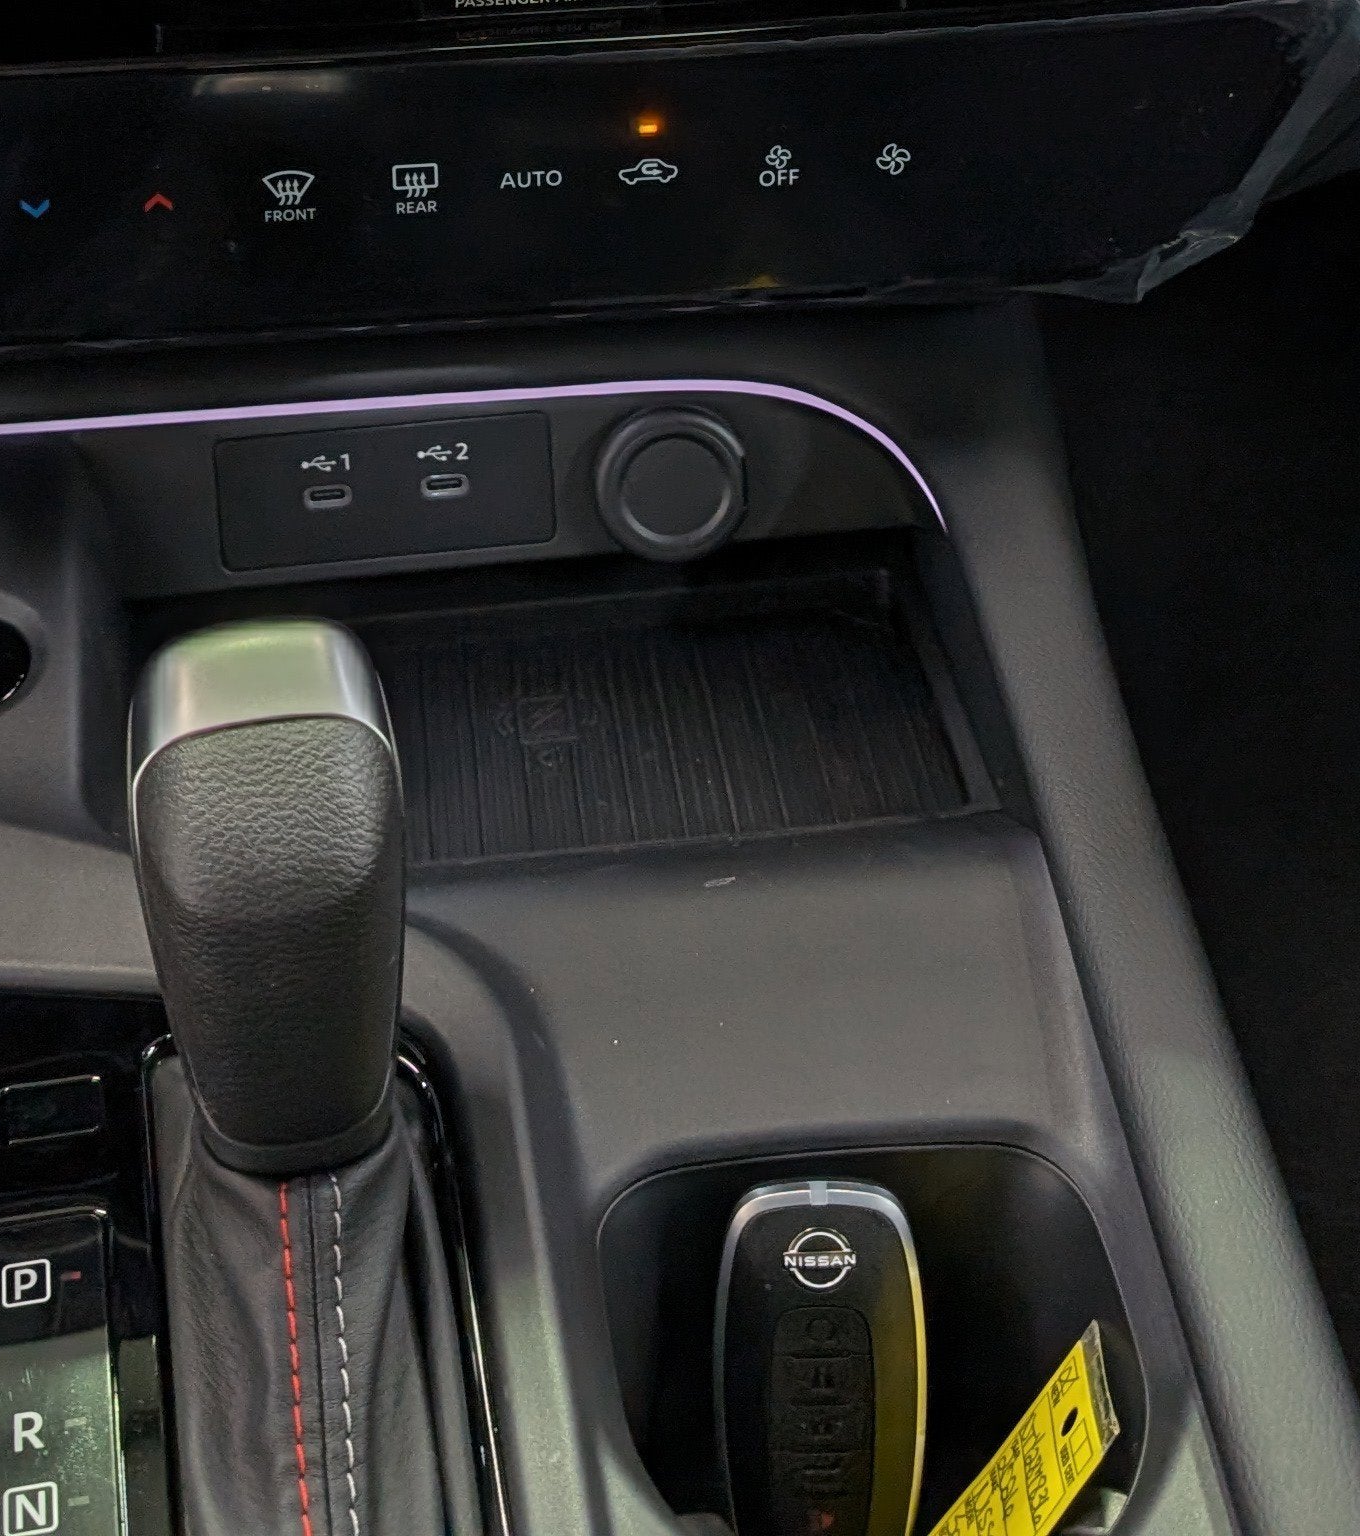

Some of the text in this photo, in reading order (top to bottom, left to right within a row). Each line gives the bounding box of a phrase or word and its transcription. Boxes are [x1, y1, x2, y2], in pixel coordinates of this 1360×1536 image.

[499, 169, 563, 189] AUTO
[759, 168, 800, 187] OFF
[264, 207, 317, 223] FRONT
[395, 200, 438, 215] REAR
[456, 443, 469, 461] 2
[341, 453, 351, 471] 1
[783, 1252, 857, 1268] NISSAN
[13, 1268, 38, 1301] P
[13, 1411, 44, 1452] R
[14, 1490, 46, 1531] N
